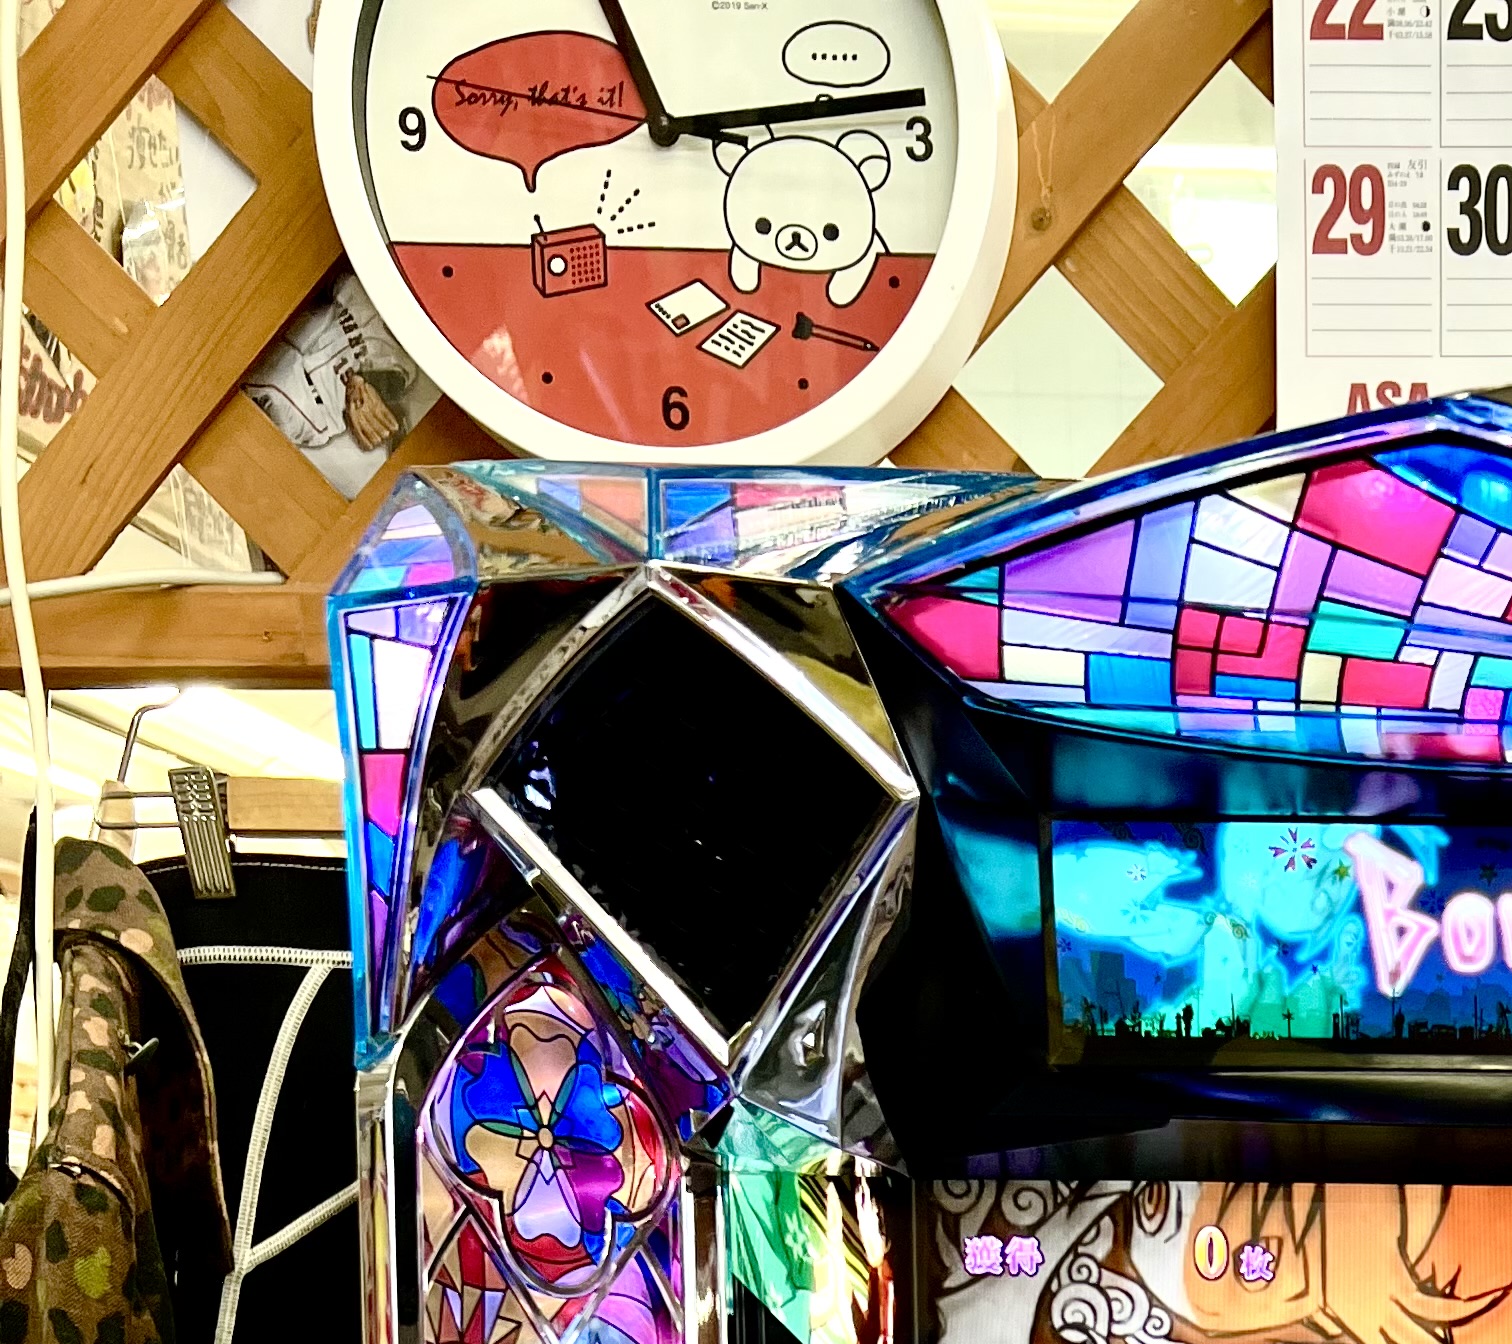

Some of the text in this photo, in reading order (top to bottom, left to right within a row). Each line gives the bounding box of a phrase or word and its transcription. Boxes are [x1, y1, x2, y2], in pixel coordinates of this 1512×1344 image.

[454, 79, 518, 116] Sorry,
[527, 80, 588, 110] that's
[398, 106, 427, 152] 9
[904, 116, 933, 162] 3
[1312, 163, 1386, 256] 29
[662, 385, 690, 431] 6
[964, 1234, 1044, 1277] 獲得
